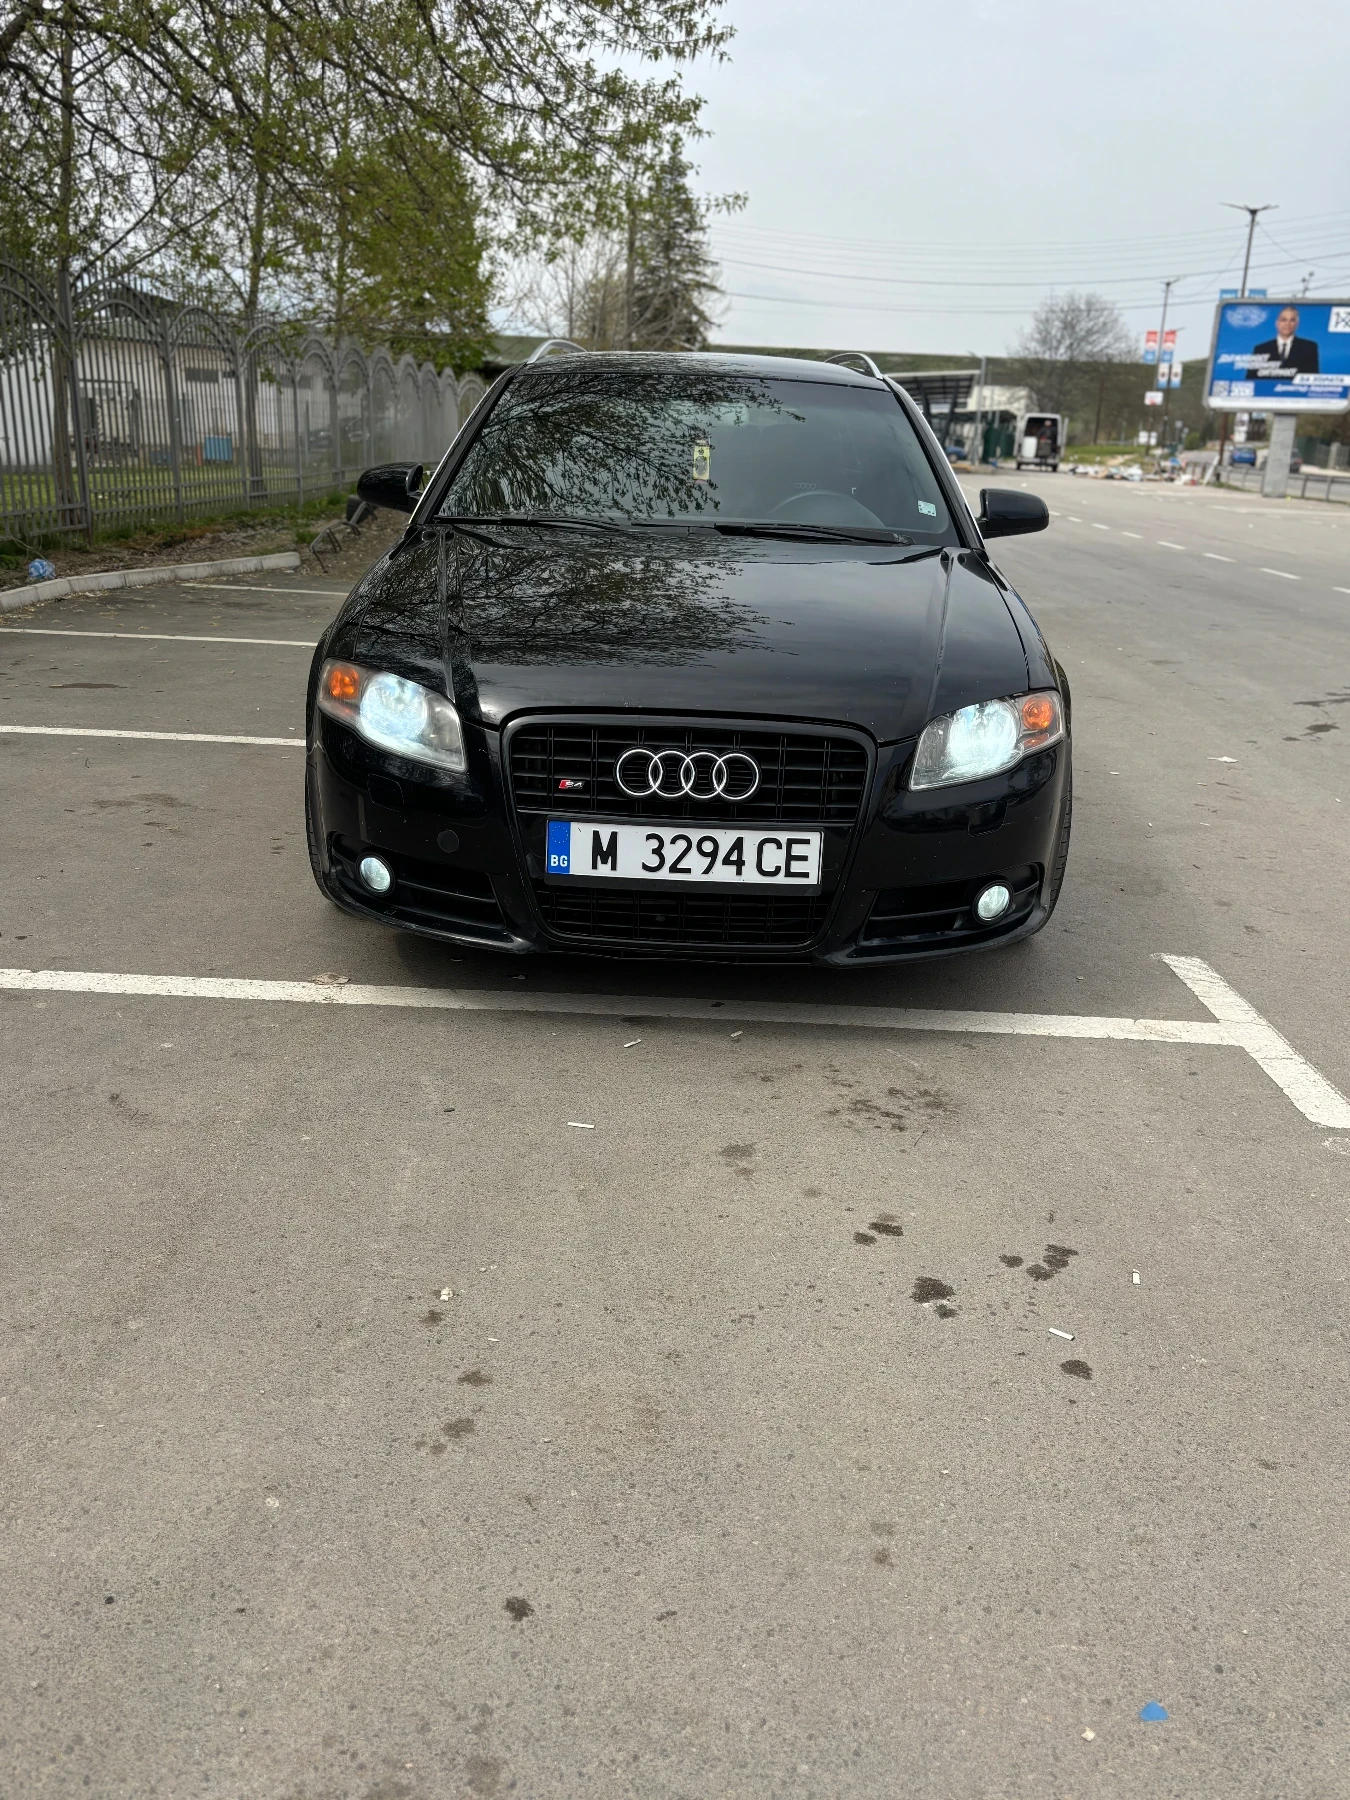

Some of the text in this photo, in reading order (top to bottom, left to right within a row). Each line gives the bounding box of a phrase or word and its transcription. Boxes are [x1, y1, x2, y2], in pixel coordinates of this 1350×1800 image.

[550, 854, 568, 868] BG
[591, 830, 811, 879] M 3294 CE
